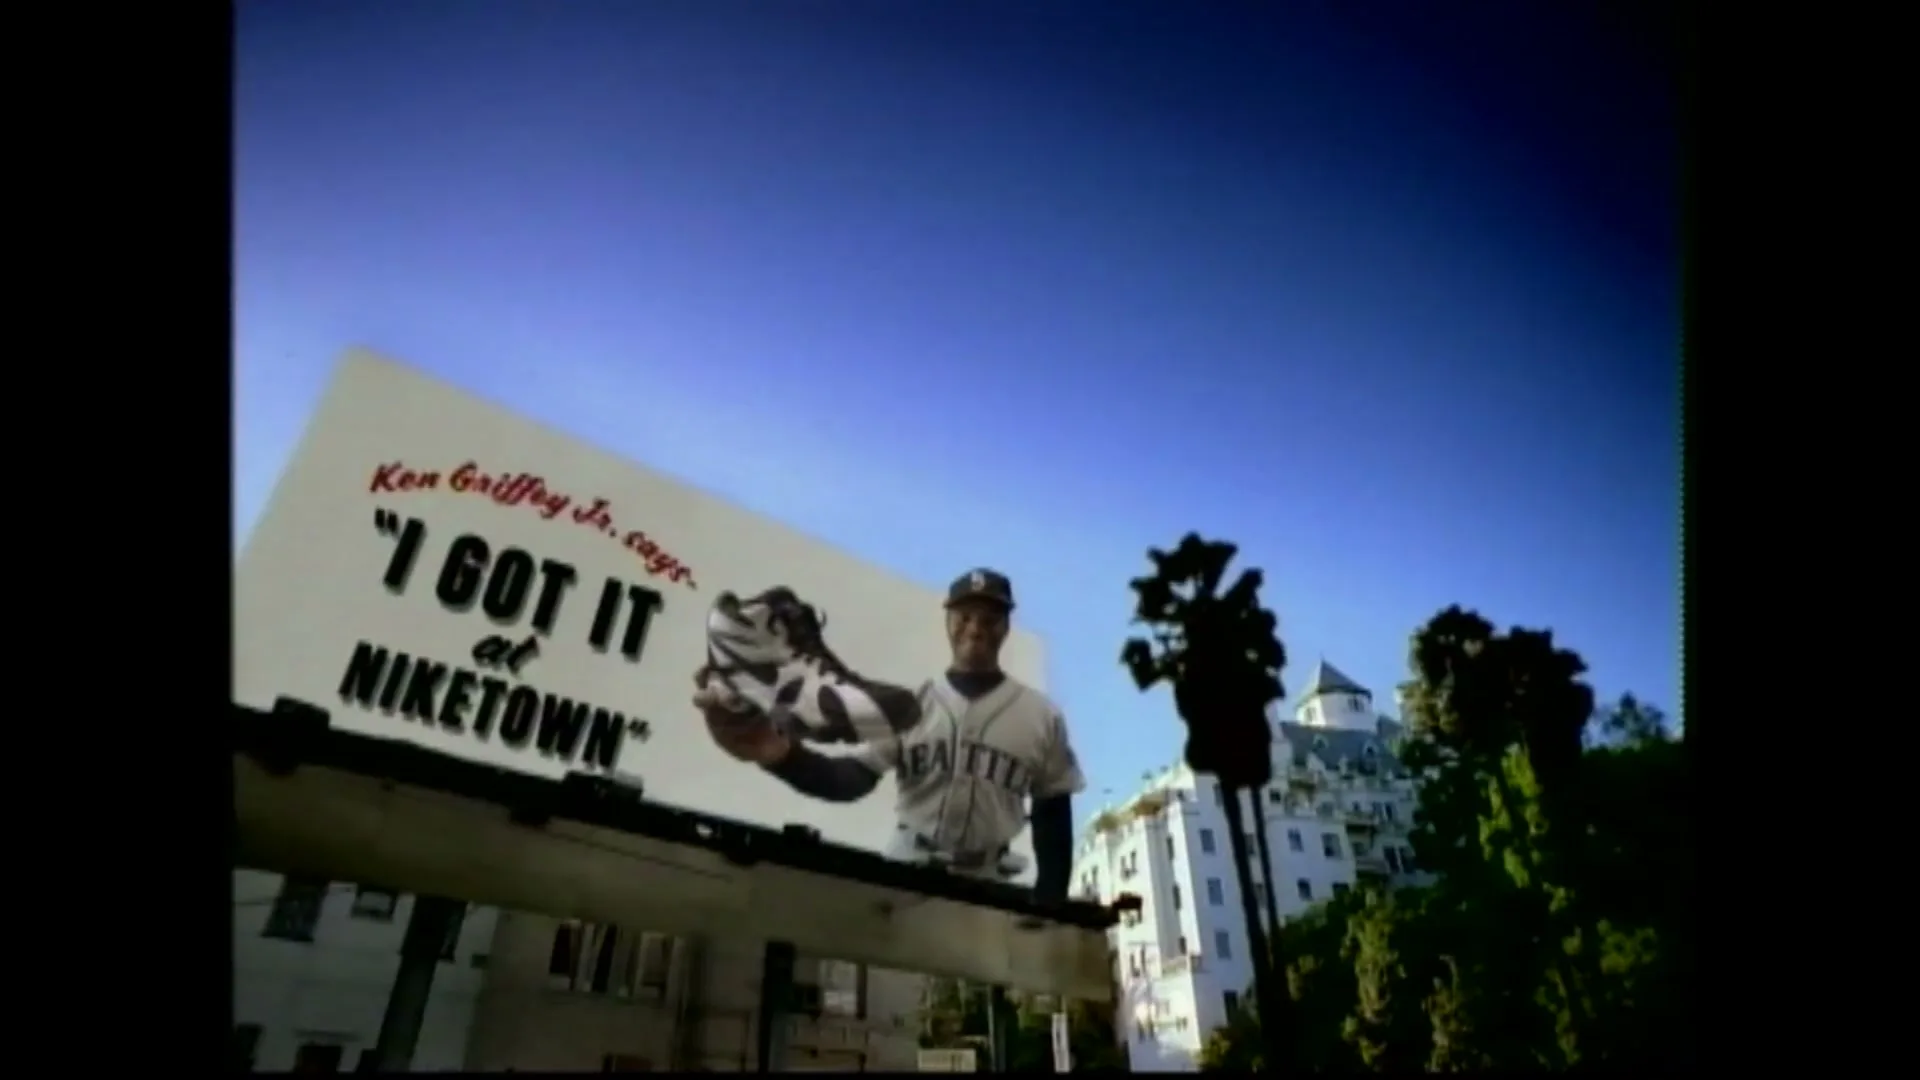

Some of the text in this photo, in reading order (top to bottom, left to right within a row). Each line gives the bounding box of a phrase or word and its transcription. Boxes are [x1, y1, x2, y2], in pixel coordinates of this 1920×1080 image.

[370, 461, 441, 493] Ken
[449, 460, 571, 520] Griffey
[573, 498, 617, 537] Jr.
[435, 533, 578, 637] GOT
[587, 577, 665, 664] IT
[471, 634, 541, 677] at
[897, 739, 1027, 797] SEATTL
